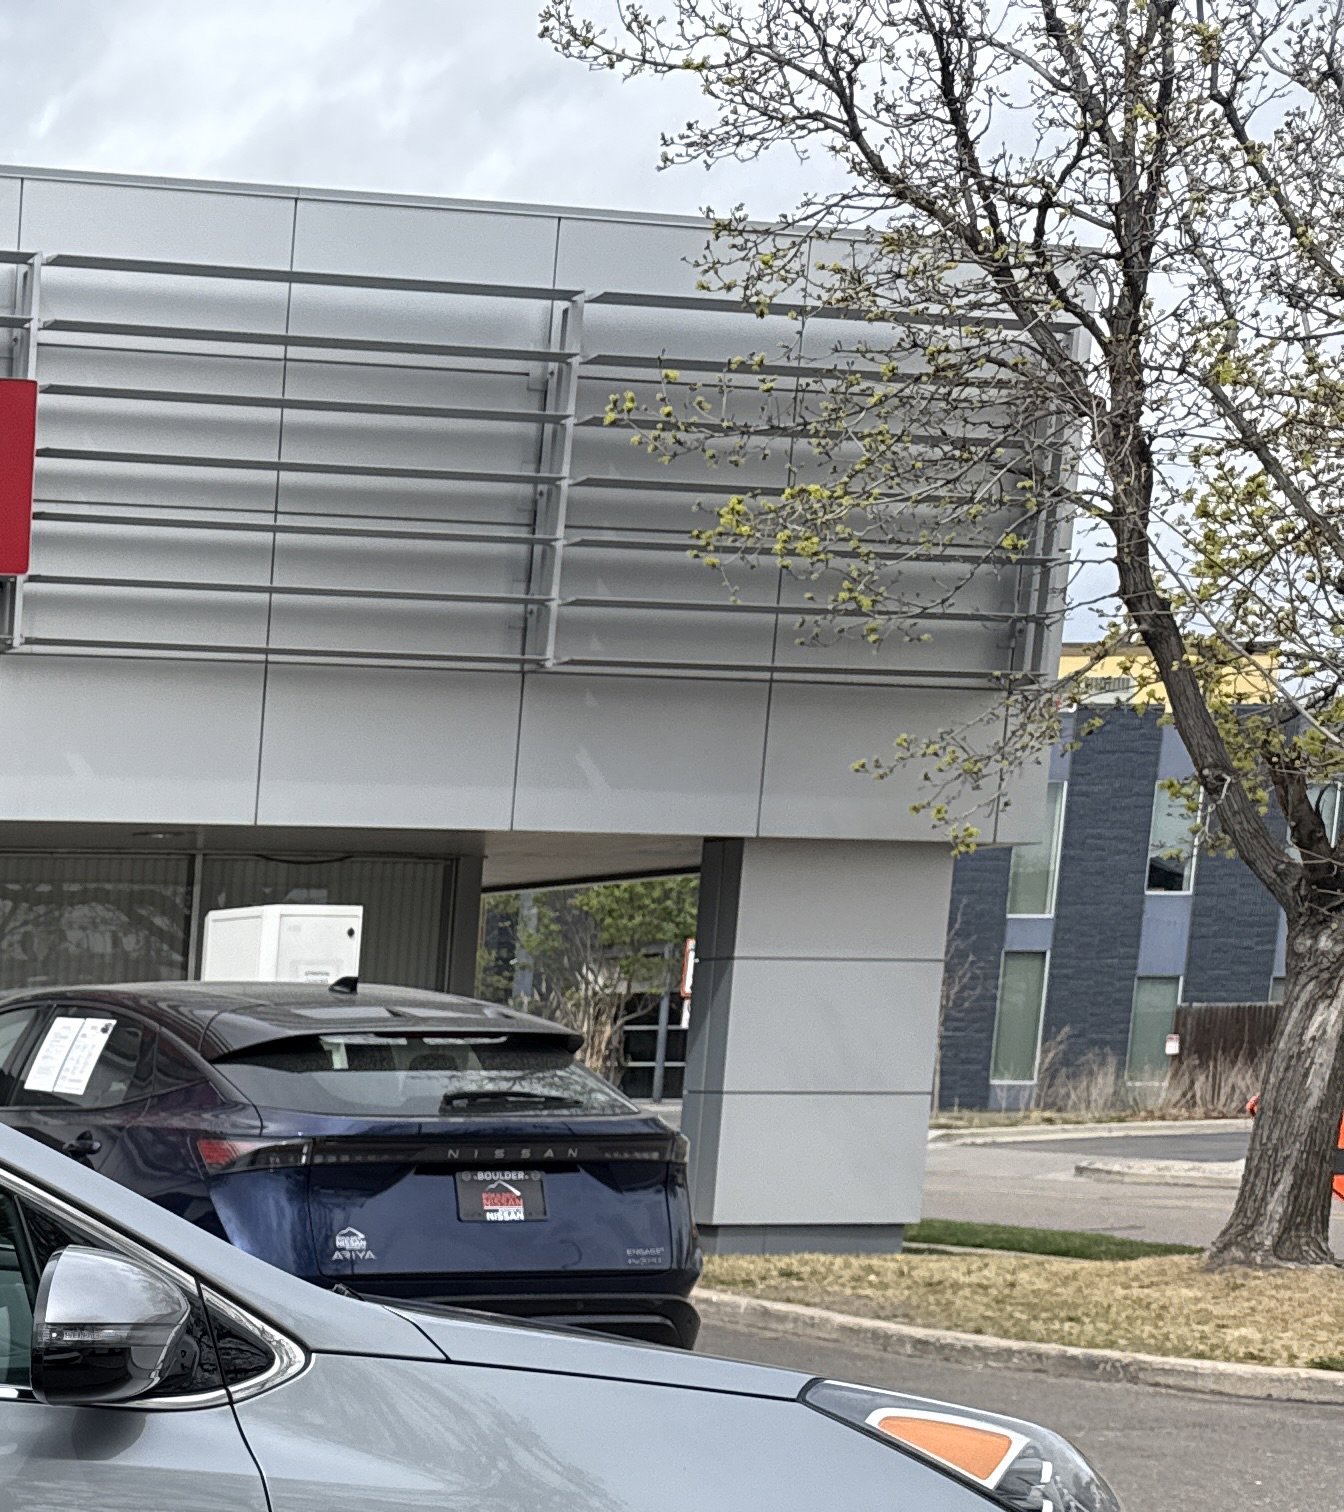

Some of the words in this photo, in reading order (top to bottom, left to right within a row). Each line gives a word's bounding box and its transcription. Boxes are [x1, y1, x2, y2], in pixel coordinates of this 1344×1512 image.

[447, 1147, 579, 1159] NISSAN
[477, 1171, 525, 1181] BOULDER
[486, 1210, 524, 1221] NISSAN
